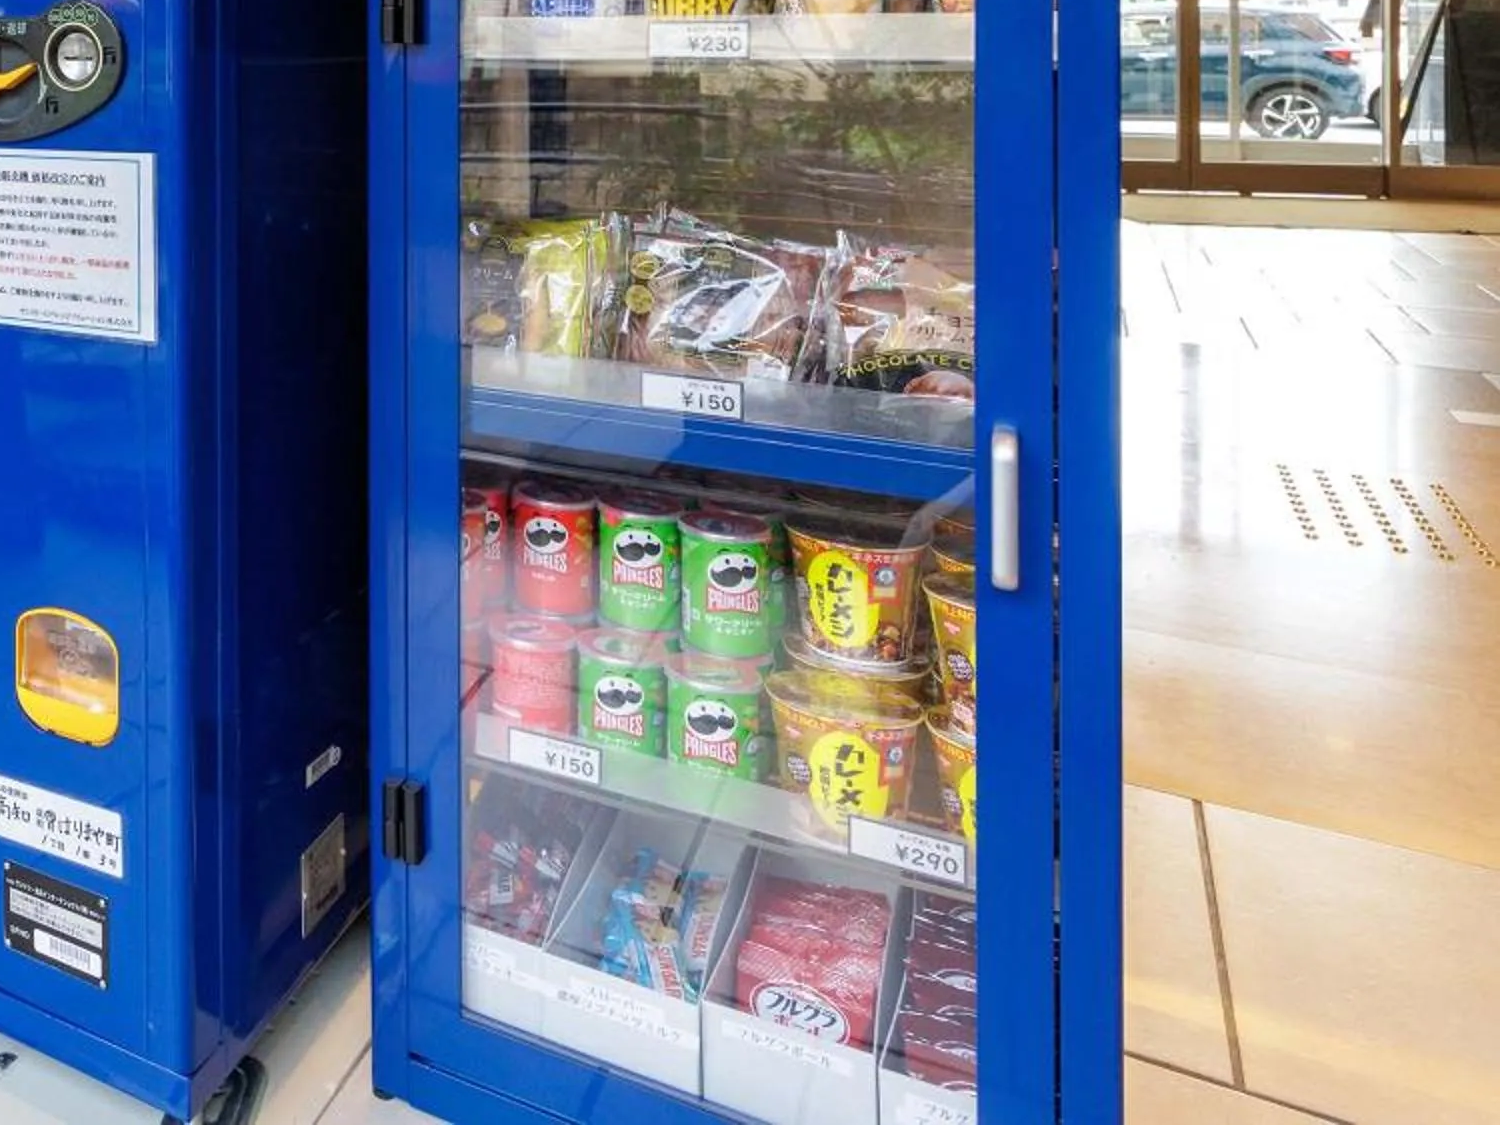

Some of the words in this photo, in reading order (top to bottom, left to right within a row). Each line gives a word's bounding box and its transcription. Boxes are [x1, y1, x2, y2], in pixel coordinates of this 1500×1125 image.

[688, 35, 743, 54] ¥230
[681, 391, 735, 413] ¥150
[524, 551, 568, 574] PRINGLES
[612, 561, 664, 590] PRINGLES
[707, 587, 760, 612] PRINGLES
[595, 711, 645, 738] PRINGLES
[545, 751, 595, 777] ¥150
[684, 739, 738, 766] PRINGLES
[895, 842, 959, 875] ¥290
[766, 990, 837, 1029] フルグラ
